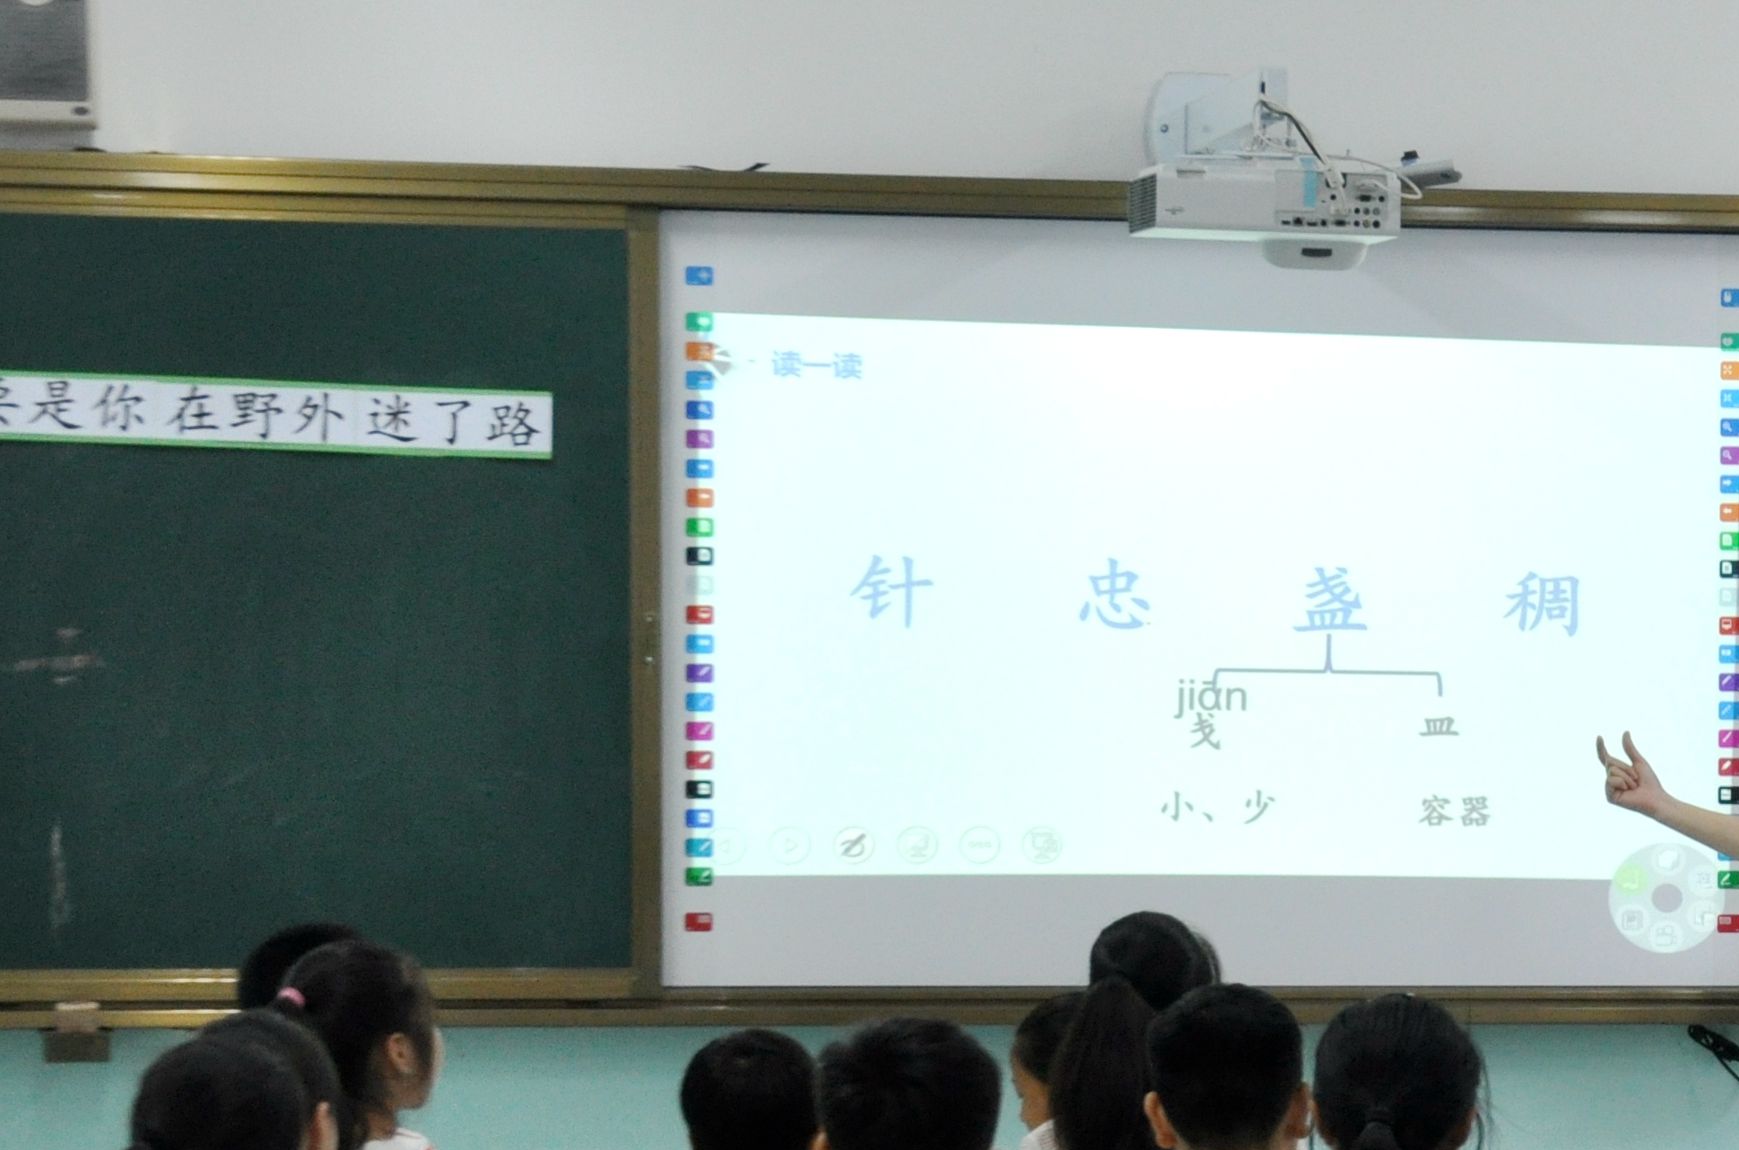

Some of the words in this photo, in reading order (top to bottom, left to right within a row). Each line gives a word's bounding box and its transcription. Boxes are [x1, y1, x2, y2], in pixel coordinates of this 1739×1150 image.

[771, 350, 864, 380] 读一读
[849, 554, 934, 629] 针
[1078, 557, 1151, 630] 忠
[1293, 565, 1368, 633] 盏
[1503, 571, 1580, 638] 稠
[1418, 715, 1460, 738] 皿
[1418, 794, 1491, 827] 容器
